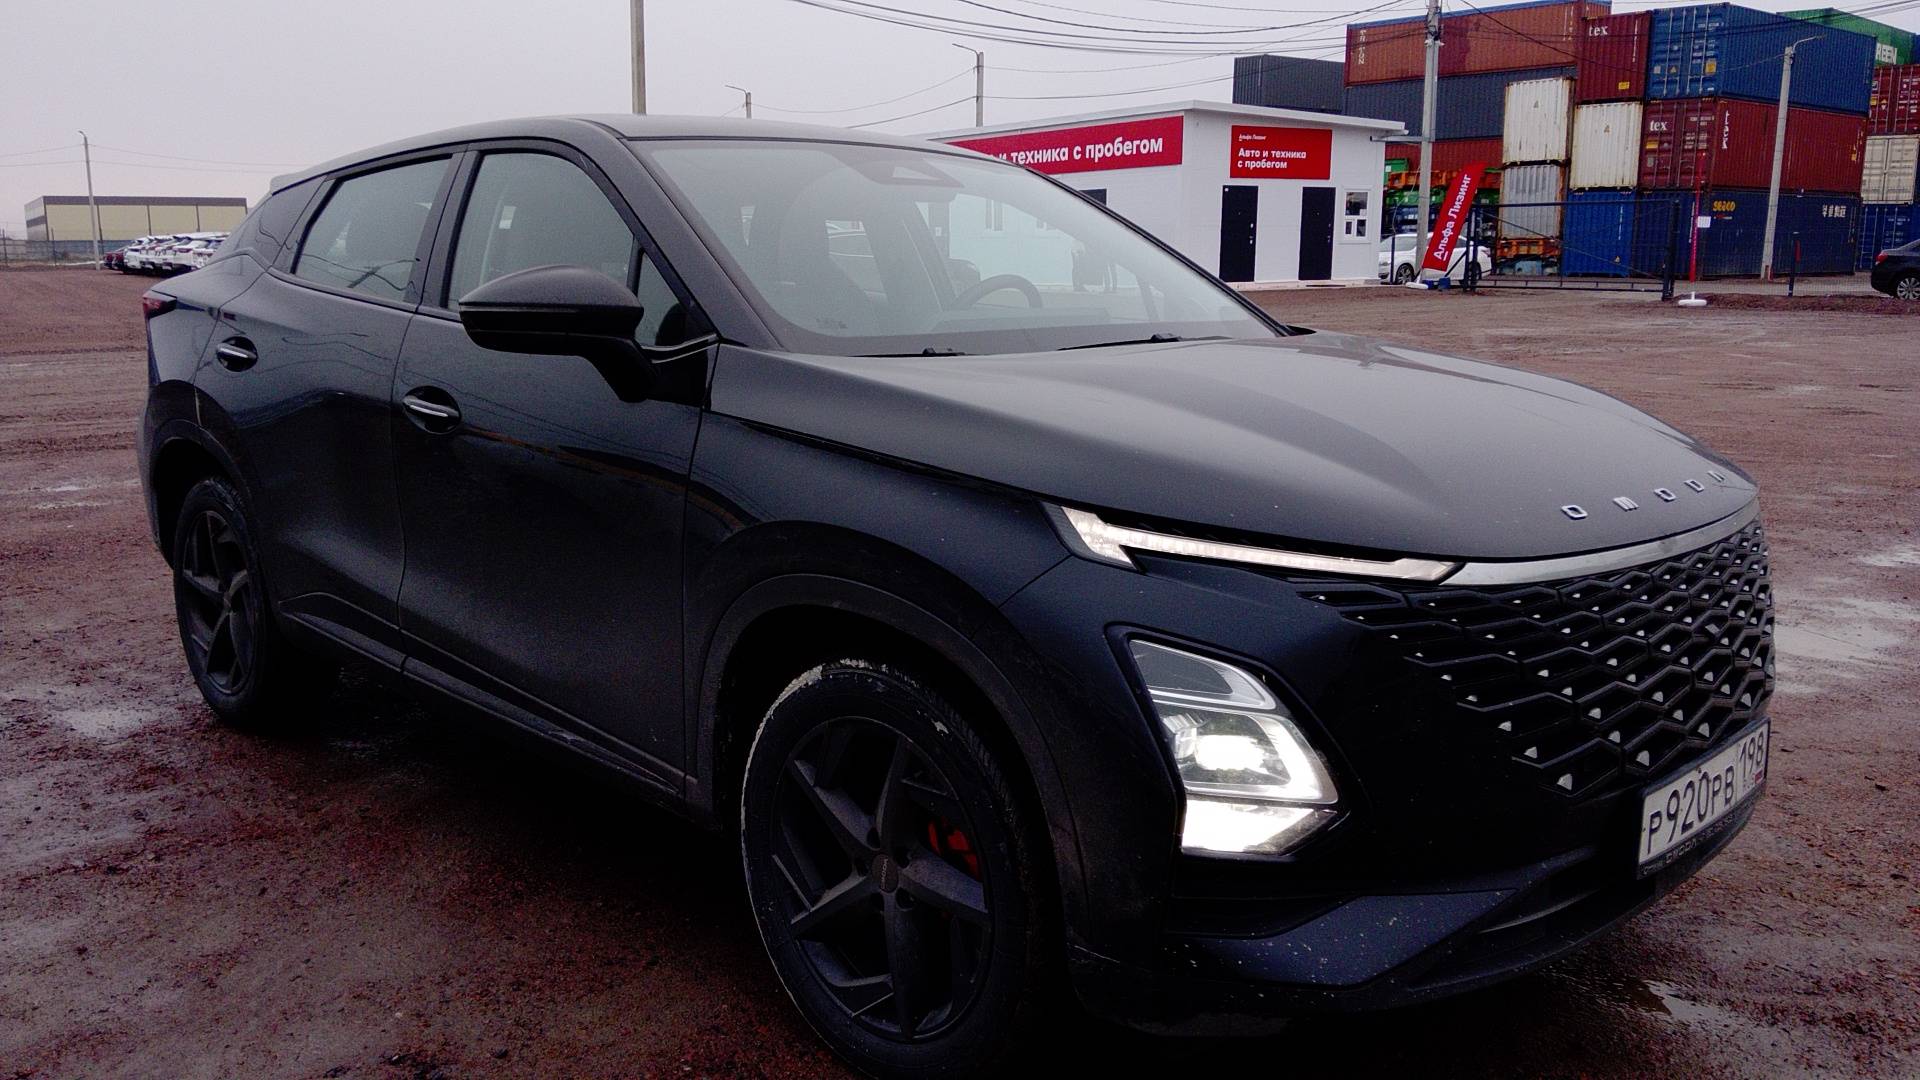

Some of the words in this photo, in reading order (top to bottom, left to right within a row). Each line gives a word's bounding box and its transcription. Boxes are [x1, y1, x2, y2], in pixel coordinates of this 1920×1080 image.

[1588, 25, 1609, 37] tex
[1649, 119, 1669, 132] tex
[1011, 147, 1069, 165] техника
[1072, 147, 1082, 160] с
[1085, 137, 1163, 163] пробегом
[1238, 147, 1261, 158] Авто
[1262, 149, 1269, 158] и
[1271, 150, 1307, 159] техника
[1237, 160, 1244, 168] с
[1245, 158, 1288, 170] пробегом
[1433, 221, 1455, 261] Альфа
[1448, 173, 1472, 219] Лизинг
[1739, 731, 1764, 778] 198
